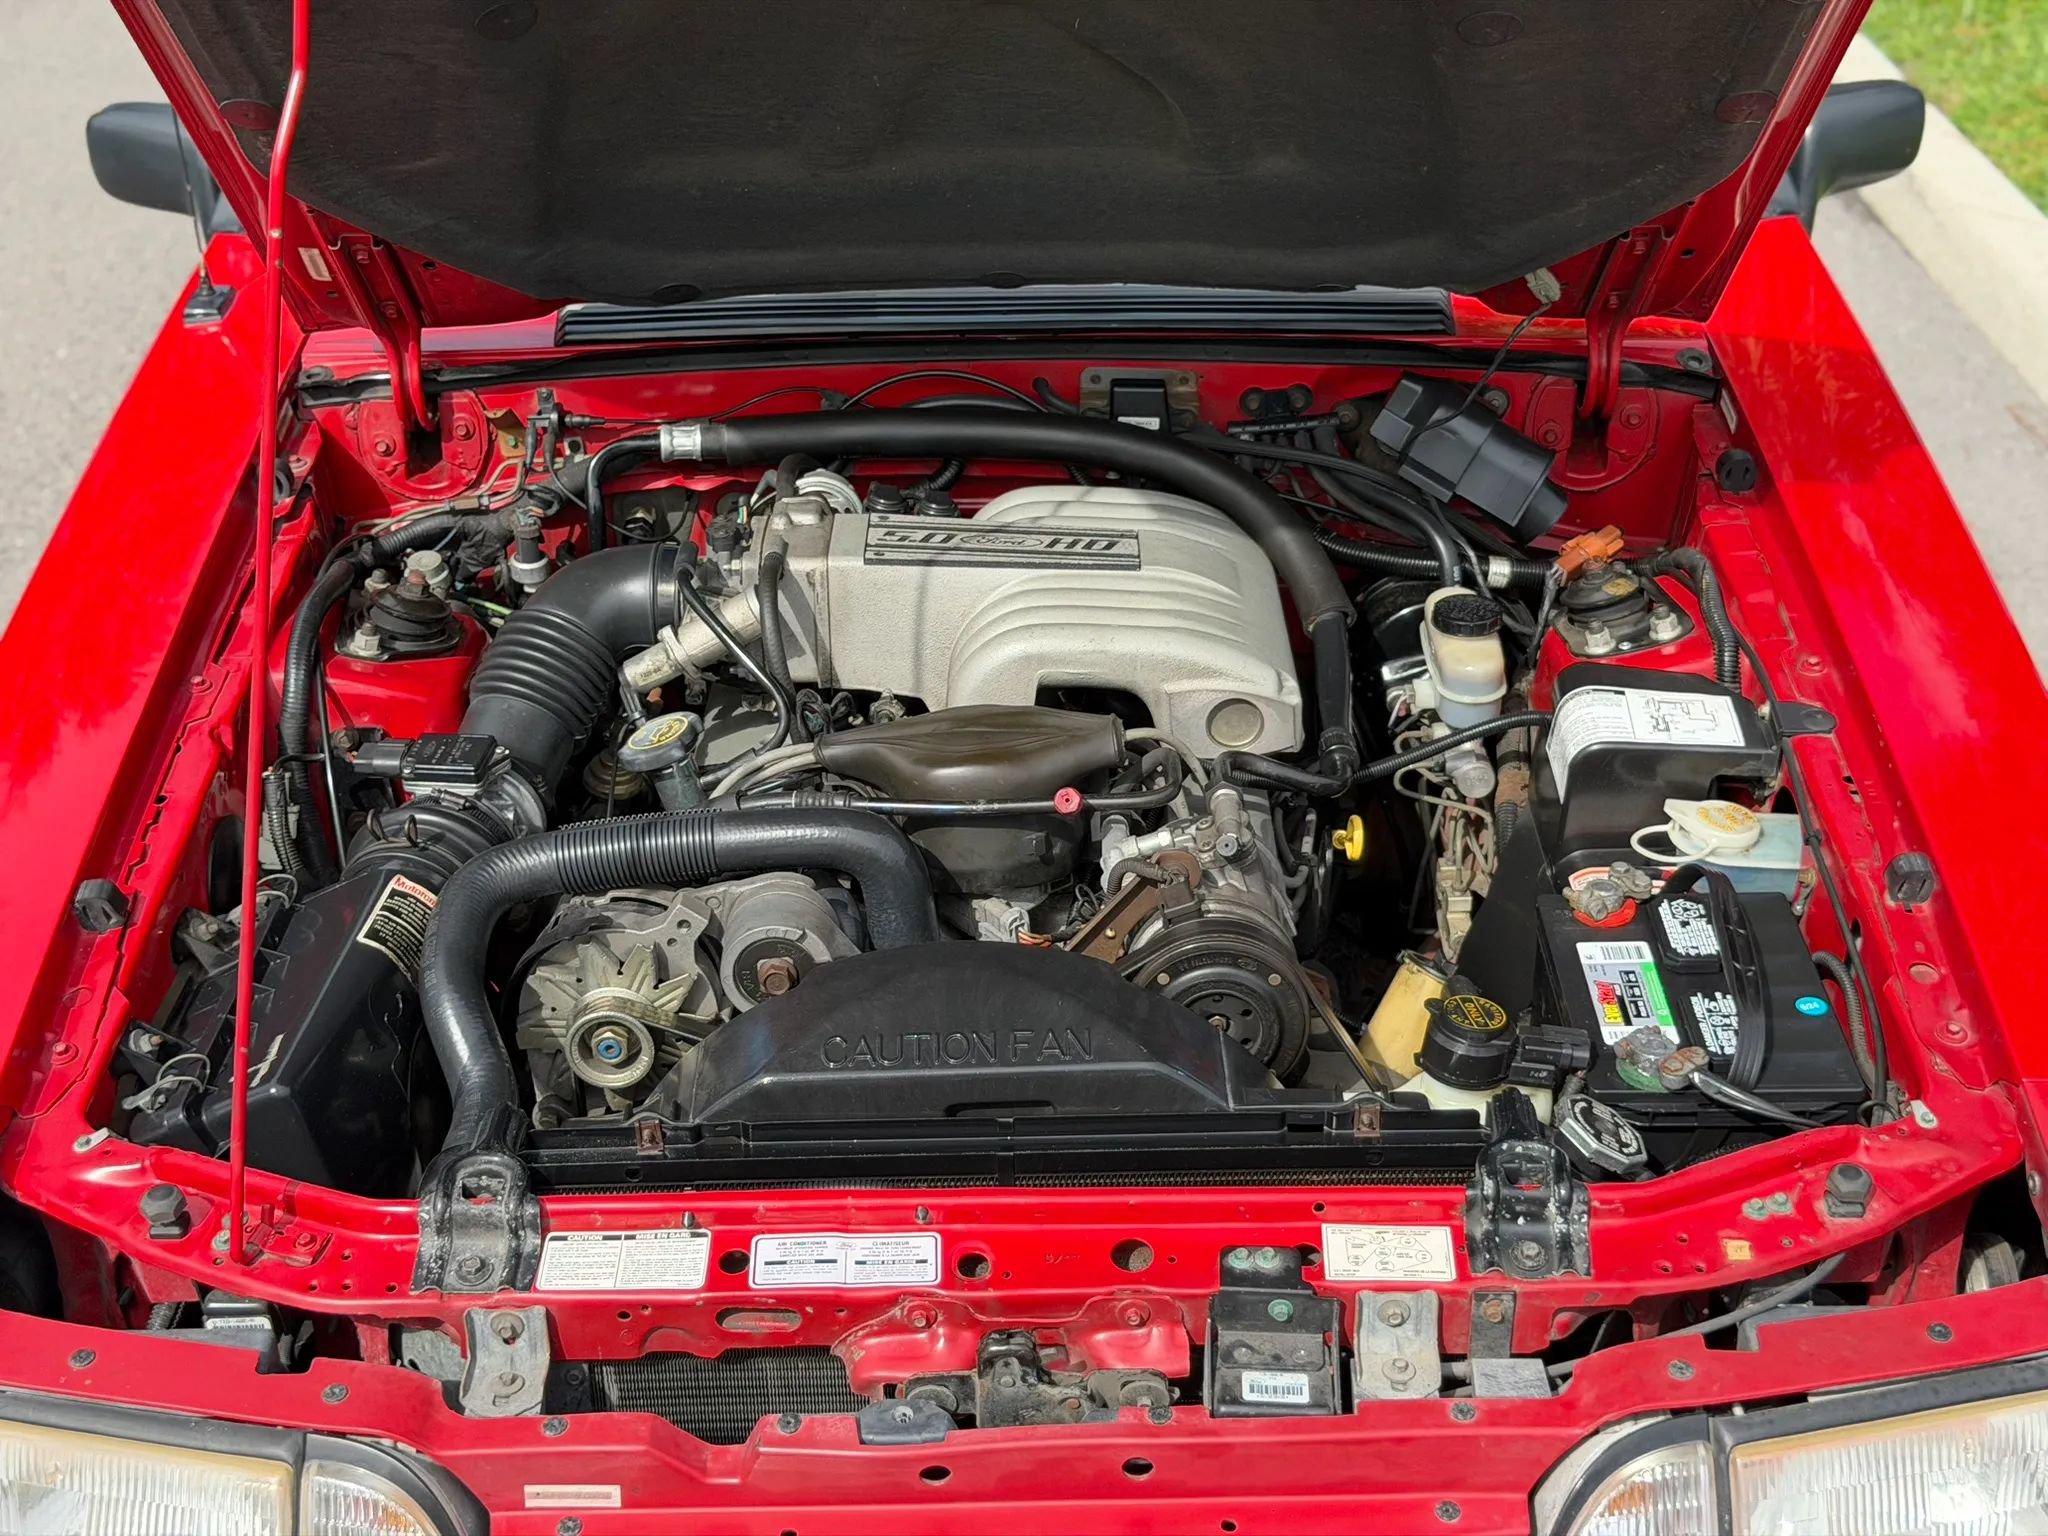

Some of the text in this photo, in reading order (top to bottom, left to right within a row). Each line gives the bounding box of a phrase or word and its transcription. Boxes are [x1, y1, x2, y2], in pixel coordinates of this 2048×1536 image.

[876, 530, 958, 545] 5.0
[1043, 537, 1121, 552] HO
[1464, 1002, 1485, 1024] ONLY
[1594, 980, 1622, 1024] EverStart
[820, 1028, 1094, 1068] CAUTION FAN
